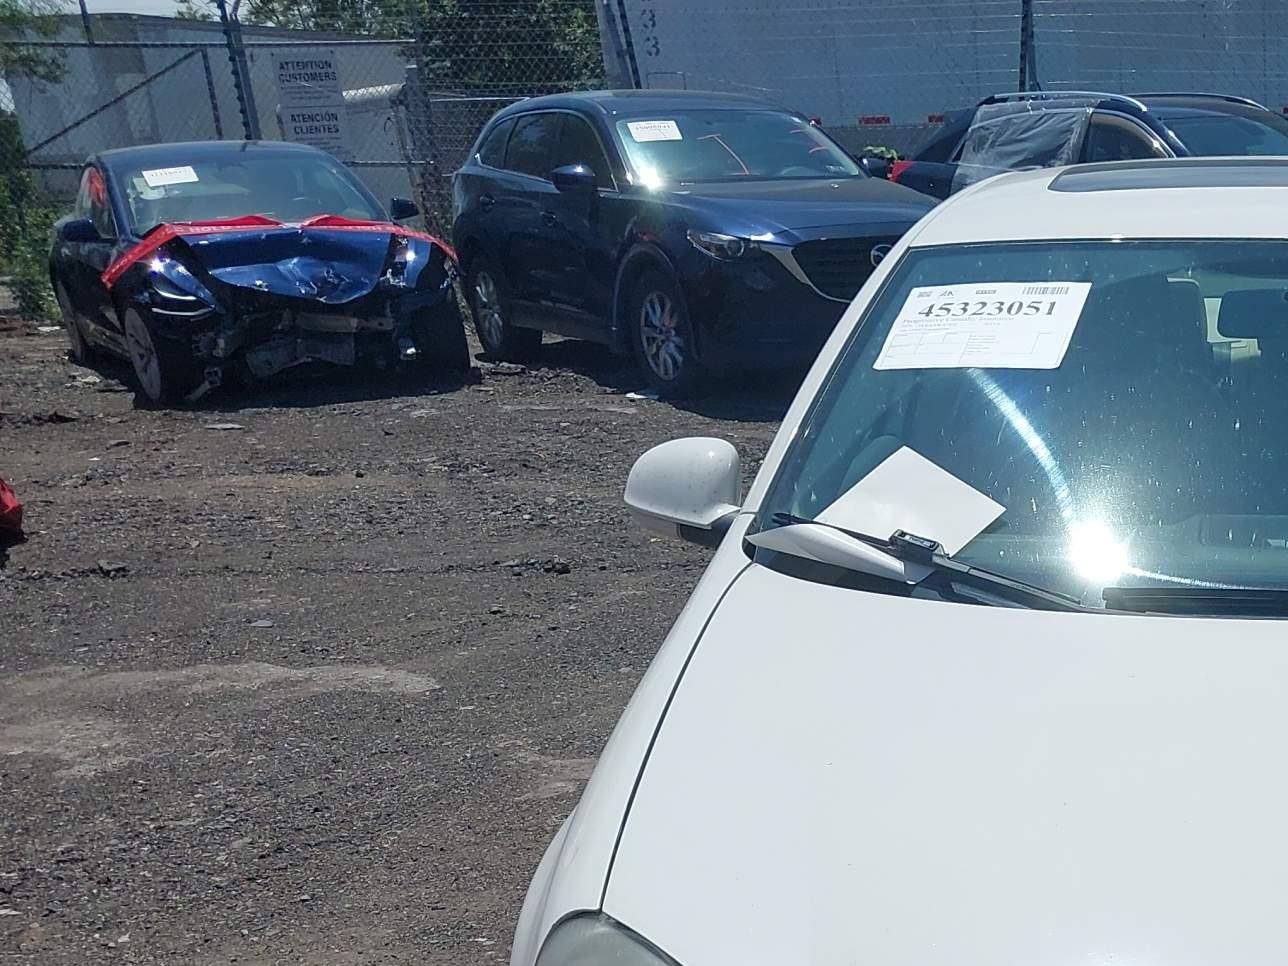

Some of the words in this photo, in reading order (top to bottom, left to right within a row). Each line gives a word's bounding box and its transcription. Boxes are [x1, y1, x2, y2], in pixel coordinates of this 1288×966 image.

[279, 60, 332, 71] ATTENTION
[279, 71, 337, 83] CUSTOMERS
[290, 111, 338, 123] ATENCIÓN
[293, 124, 340, 135] CLIENTES
[917, 300, 1057, 318] 45323051
